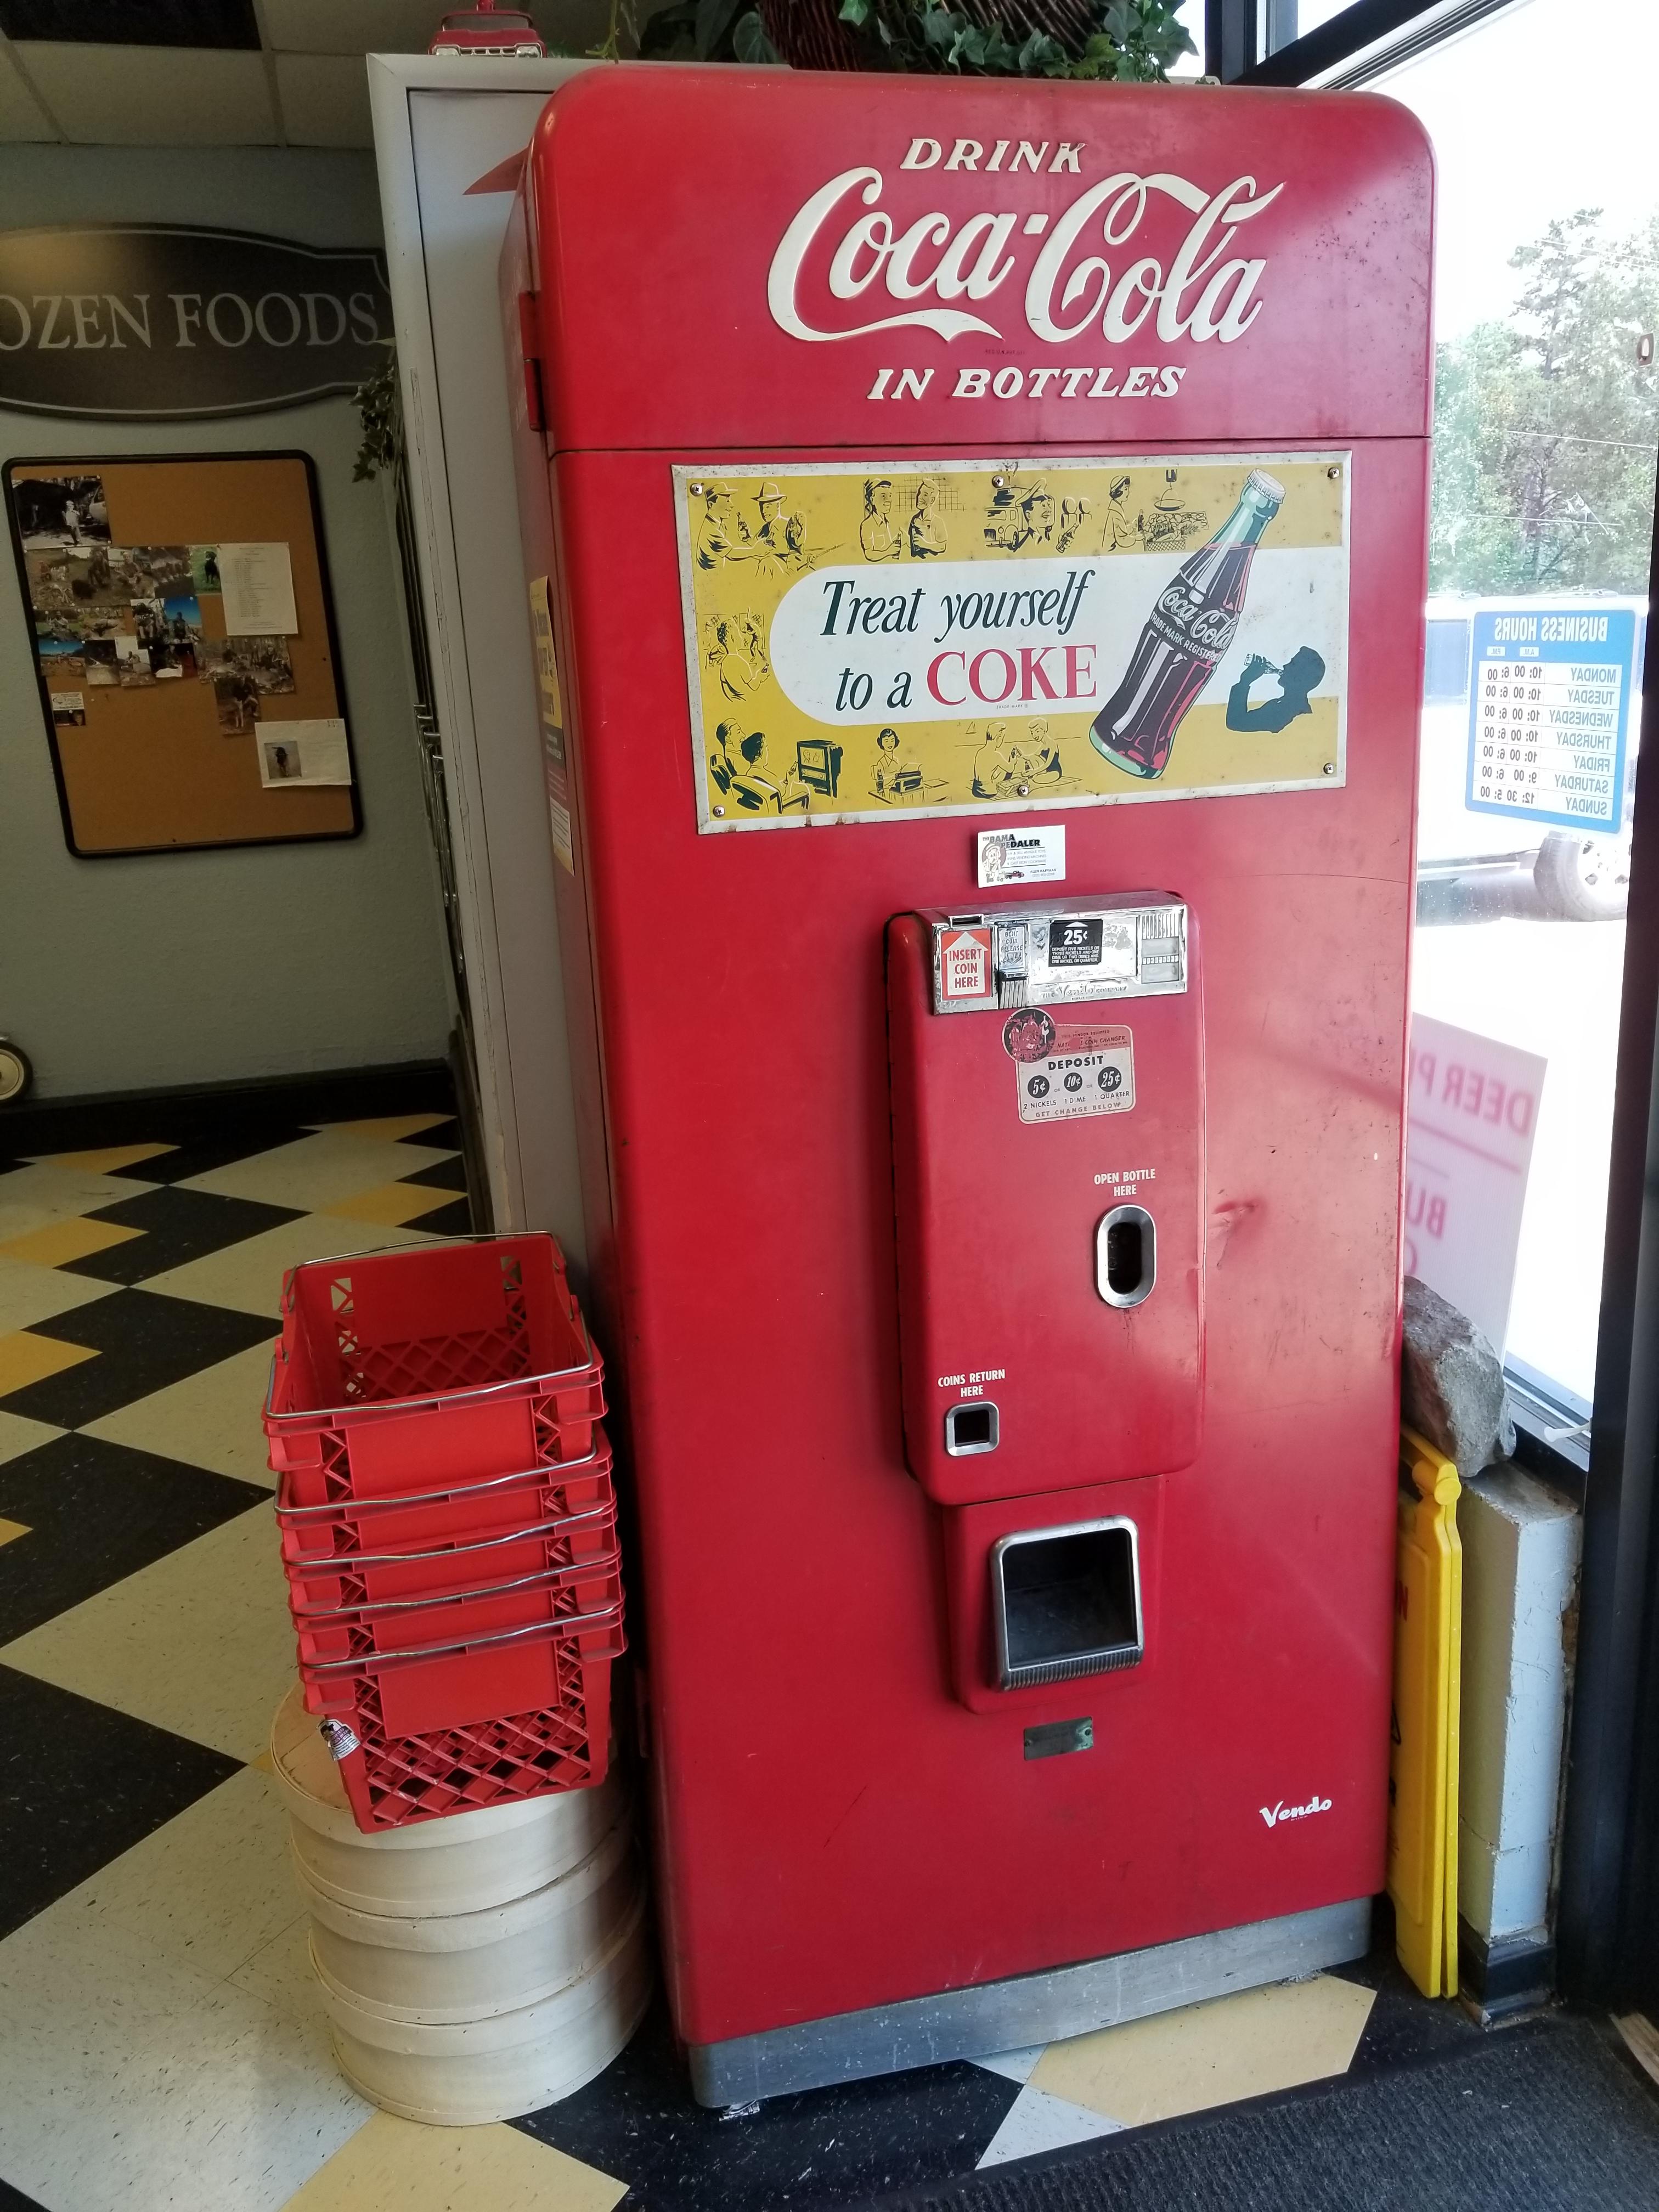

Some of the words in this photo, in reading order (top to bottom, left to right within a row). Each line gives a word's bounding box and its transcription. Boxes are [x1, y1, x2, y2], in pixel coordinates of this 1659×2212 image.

[899, 138, 1088, 173] DRINK
[767, 166, 1286, 344] Coca-Cola
[167, 292, 379, 348] FOODS
[867, 368, 935, 400] IN
[952, 365, 1188, 399] BOTTLES
[819, 580, 926, 637] Treat
[934, 569, 1097, 644] yourself
[1158, 586, 1239, 650] Coca-Cola
[1150, 611, 1166, 632] TRADE
[1163, 626, 1185, 646] MARK
[835, 667, 873, 712] to
[893, 672, 913, 709] a
[926, 644, 1098, 707] COKE
[990, 833, 1015, 843] BAMA
[1001, 839, 1040, 849] PEDALER
[1063, 929, 1088, 945] 25¢
[949, 948, 982, 961] INSERT
[955, 962, 978, 974] COIN
[955, 976, 979, 989] HERE
[1048, 1055, 1104, 1071] DEPOSIT
[1032, 1079, 1046, 1096] 5¢
[1066, 1075, 1081, 1088] 10¢
[1101, 1070, 1120, 1088] 25¢
[1030, 1100, 1057, 1109] NICKELS
[1100, 1091, 1130, 1100] QUARTER
[1054, 1106, 1088, 1115] CHANGE
[1092, 1102, 1121, 1111] BELOW
[1094, 1172, 1120, 1185] OPEN
[1122, 1168, 1156, 1182] BOTTLE
[1114, 1184, 1137, 1197] HERE
[938, 1374, 966, 1387] COINS
[969, 1369, 1006, 1383] RETURN
[961, 1385, 984, 1397] HERE
[1259, 1796, 1333, 1829] Vendo
